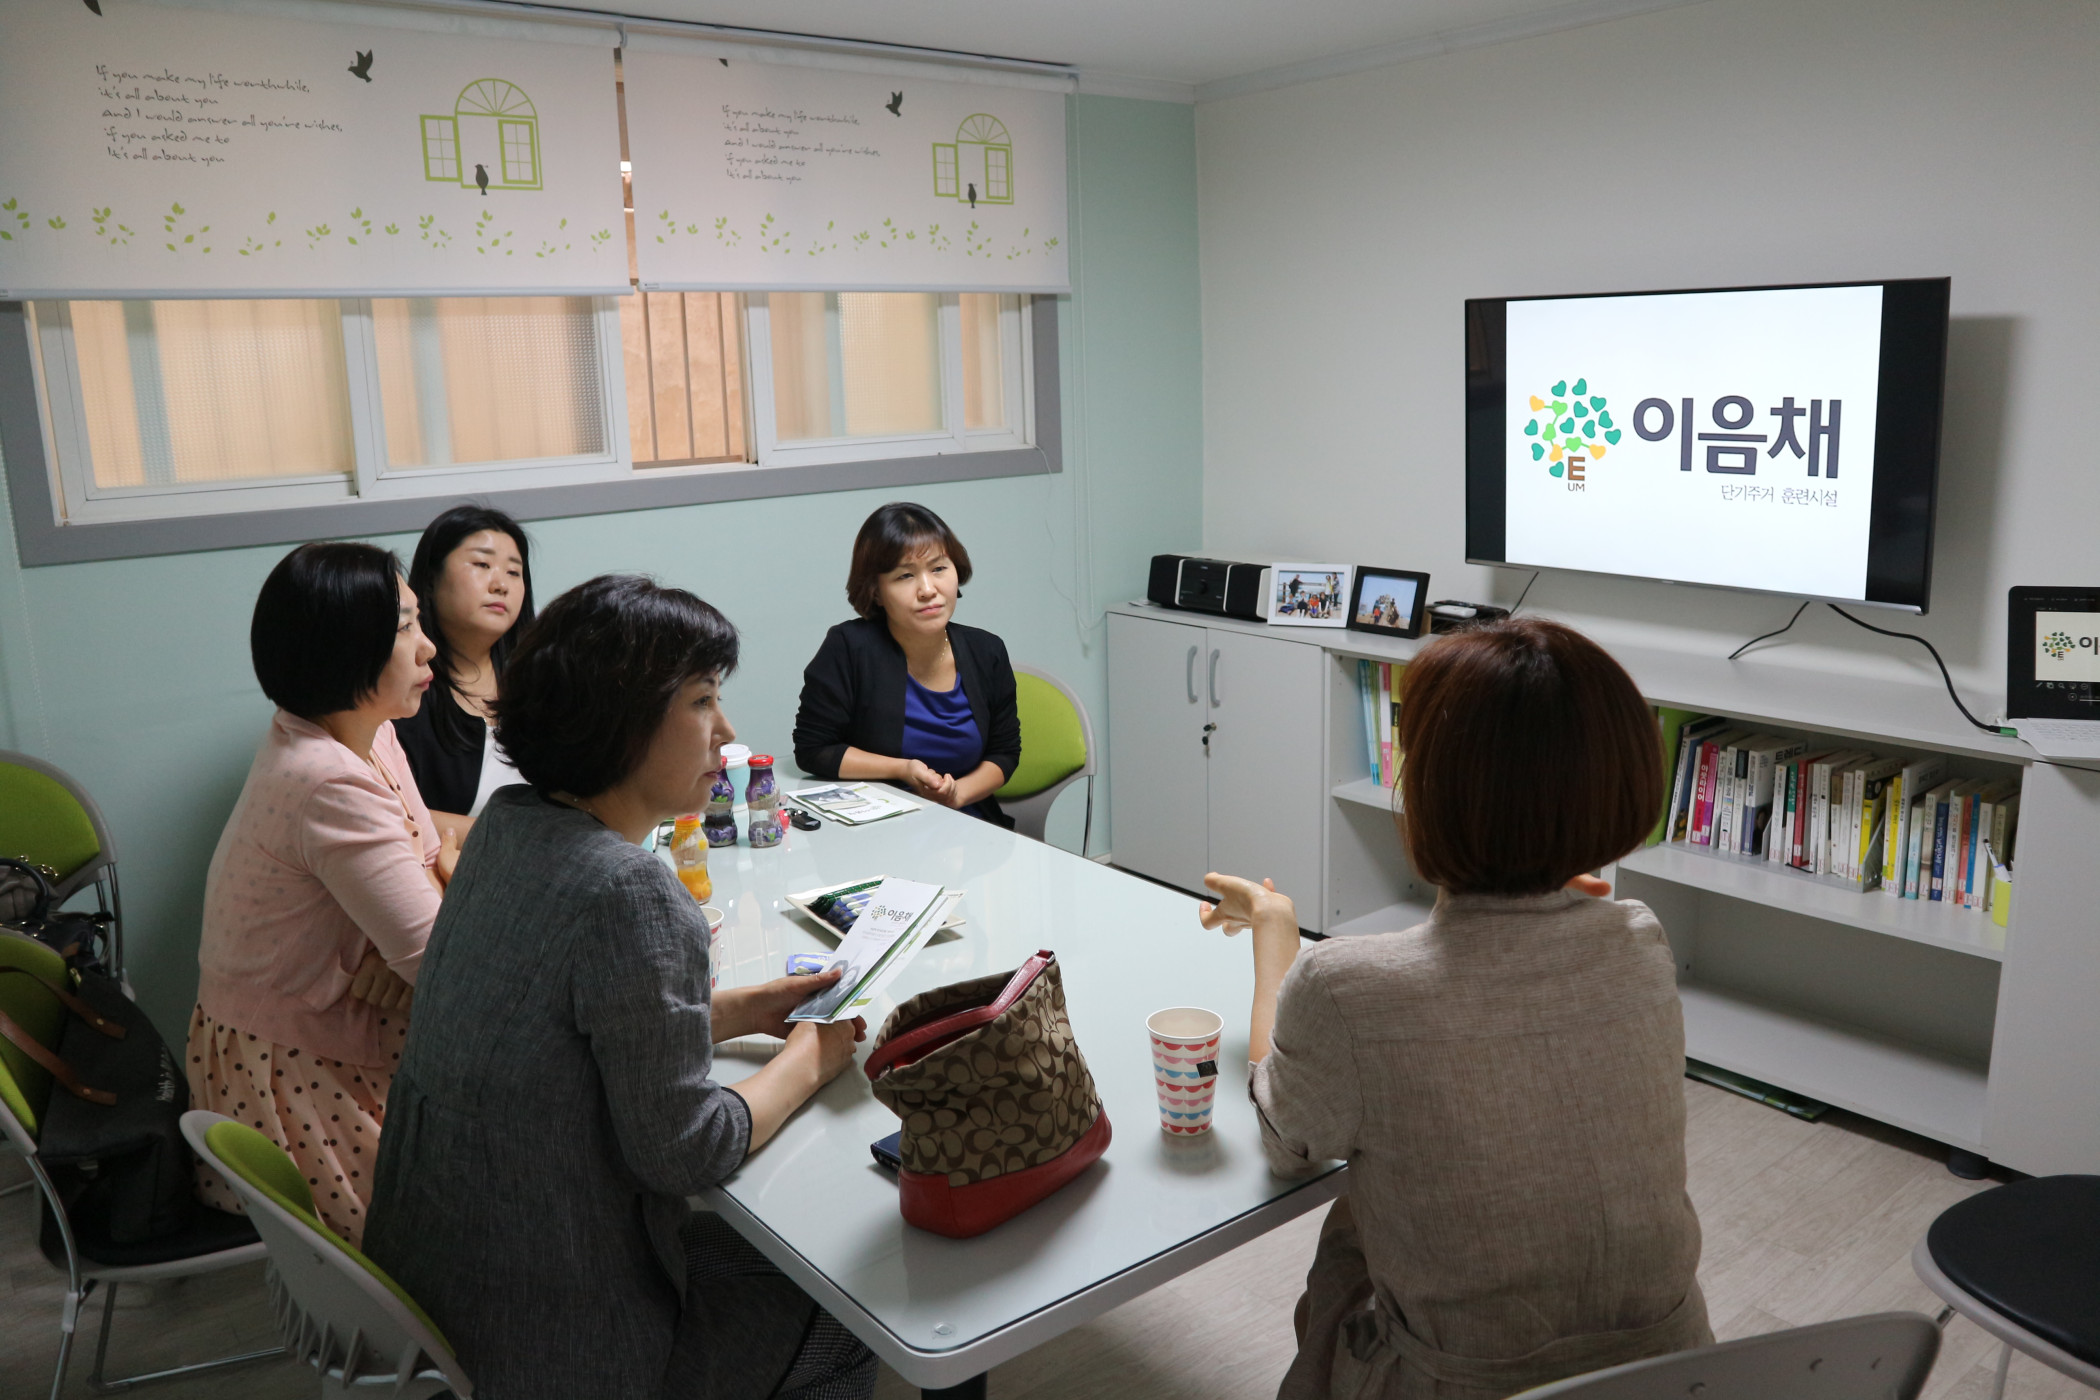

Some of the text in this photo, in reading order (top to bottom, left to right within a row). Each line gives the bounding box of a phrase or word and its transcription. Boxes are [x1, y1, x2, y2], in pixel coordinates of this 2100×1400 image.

[96, 65, 108, 81] If
[113, 72, 138, 84] you
[143, 68, 180, 84] make
[184, 78, 206, 90] my
[209, 73, 229, 90] life
[125, 88, 140, 101] all
[145, 89, 190, 104] about
[194, 98, 219, 109] you
[102, 107, 132, 119] And
[145, 109, 183, 122] would
[241, 114, 256, 127] all
[103, 126, 230, 145] if you asked me to
[132, 147, 148, 161] all
[152, 149, 197, 163] about
[201, 156, 226, 168] you
[1632, 396, 1842, 479] 이음채
[1567, 456, 1586, 481] E
[1567, 482, 1586, 493] UM
[1721, 484, 1838, 508] 단기주거 훈련시설
[2079, 637, 2100, 655] 이
